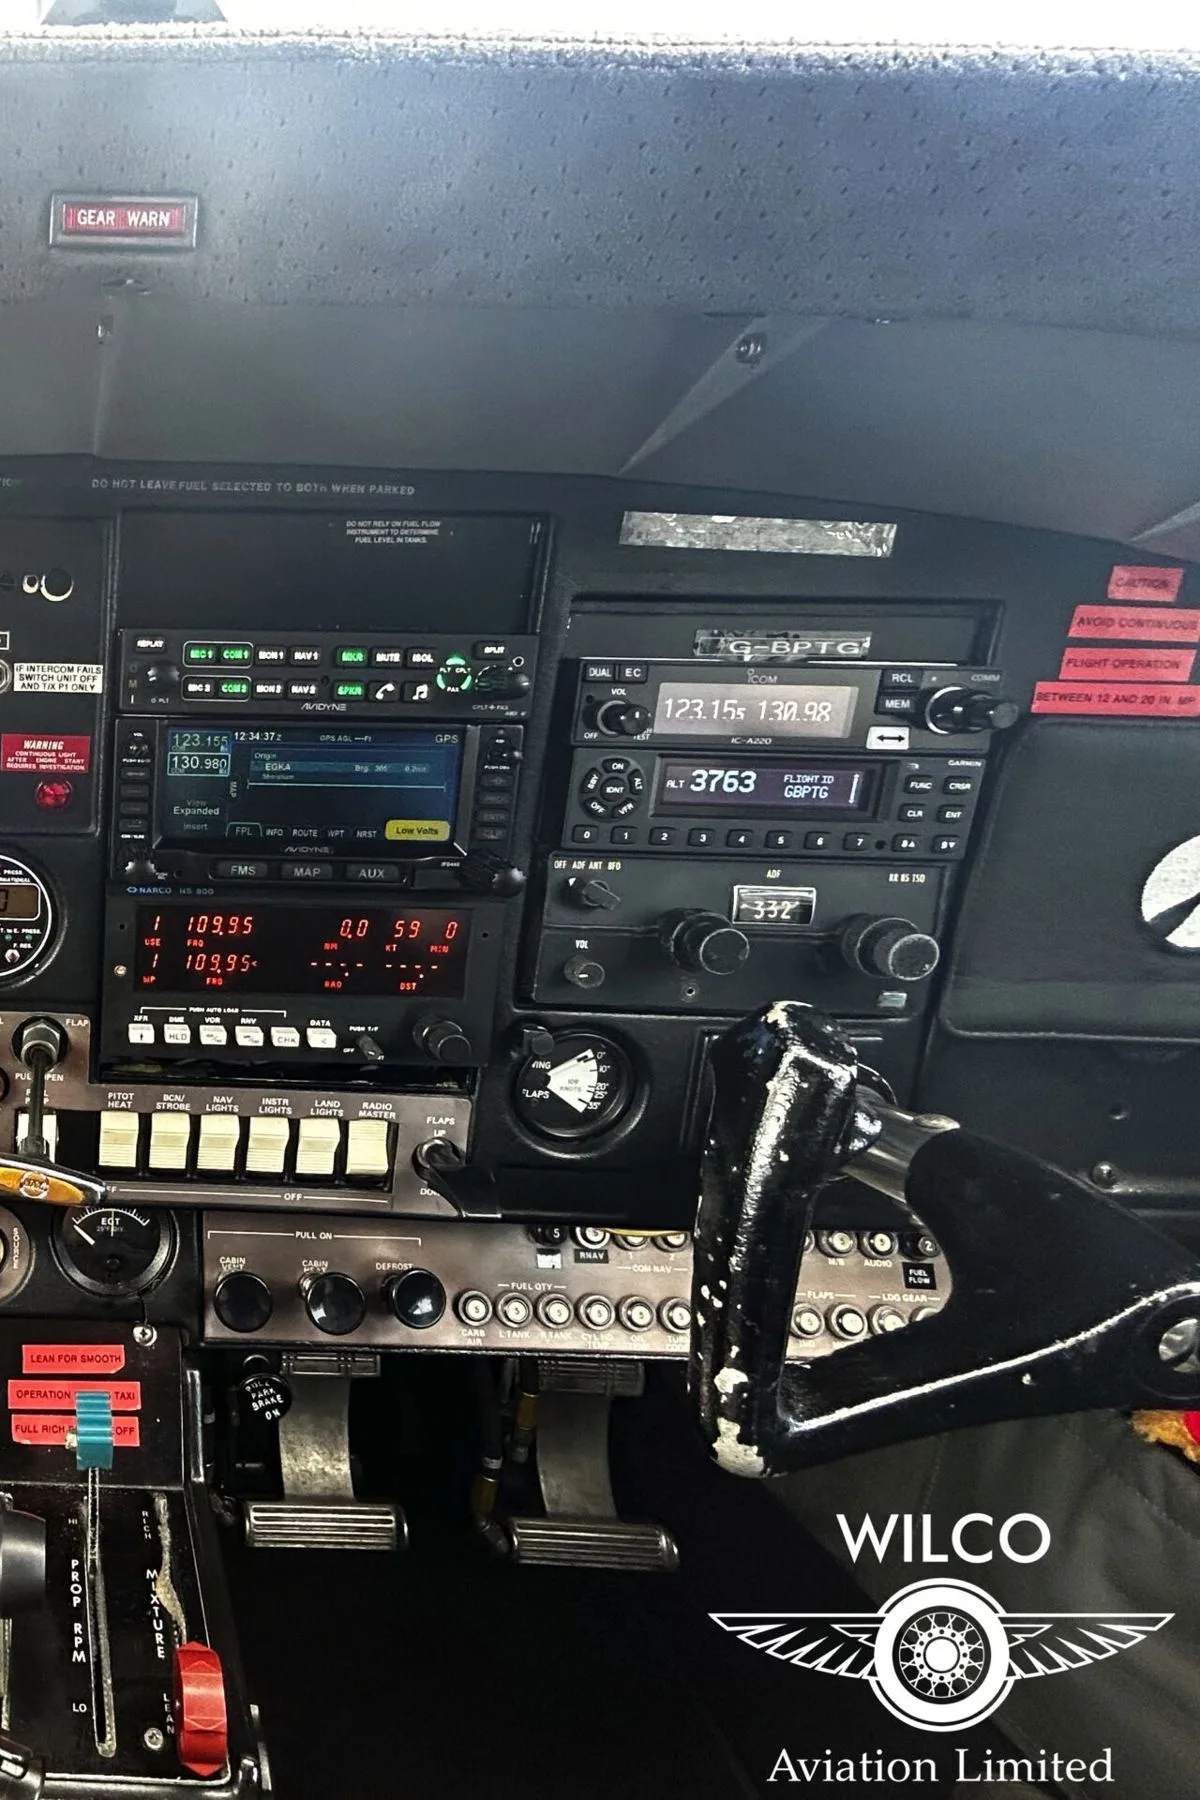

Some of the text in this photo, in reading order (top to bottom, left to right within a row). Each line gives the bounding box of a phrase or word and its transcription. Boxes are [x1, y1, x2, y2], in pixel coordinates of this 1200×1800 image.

[77, 210, 170, 226] GEAR WARN
[140, 480, 415, 495] LEAVE FUEL TO WHEN PARKED
[729, 641, 860, 654] G-BPTG
[376, 654, 433, 662] MUTE ISOL
[1066, 658, 1181, 669] FLIGHT OPERATION
[26, 665, 74, 674] INTERCOM
[77, 666, 101, 674] FAILS
[589, 668, 611, 677] DUAL
[891, 674, 914, 683] RCL
[1036, 692, 1155, 704] BETWEEN 12 AND 20
[301, 702, 346, 711] AVIDYNE
[885, 699, 910, 708] MEM
[173, 733, 228, 746] 123.155
[435, 734, 458, 744] GPS
[24, 740, 64, 750] WARNING
[172, 756, 227, 769] 130.980
[666, 769, 756, 792] ALT 3763
[784, 775, 834, 784] FLIGHT ID
[784, 786, 828, 798] GBPTG
[173, 806, 219, 816] Expanded
[417, 827, 439, 835] Volts
[230, 866, 256, 876] FMS
[294, 867, 320, 877] MAP
[359, 868, 385, 879] AUX
[187, 915, 253, 935] 109.95
[394, 920, 421, 938] 59
[156, 1102, 191, 1110] STROBE
[262, 1098, 289, 1106] INSTR
[362, 1102, 392, 1110] RADIO
[259, 1106, 292, 1115] LIGHTS
[310, 1108, 344, 1117] LIGHTS
[358, 1110, 396, 1119] MASTER
[427, 1117, 455, 1125] FLAPS
[284, 1192, 302, 1201] OFF
[296, 1231, 316, 1239] PULL
[535, 1283, 552, 1291] QTY
[31, 1354, 121, 1364] LEAN FOR SMOOTH
[16, 1390, 70, 1399] OPERATION
[114, 1392, 135, 1400] TAXI
[252, 1388, 276, 1400] PARK
[252, 1395, 284, 1411] BRAKE
[15, 1425, 66, 1434] FULL RICH
[70, 1560, 86, 1662] PROP RPM
[146, 1570, 165, 1658] MIXTURE
[72, 1704, 86, 1712] LO
